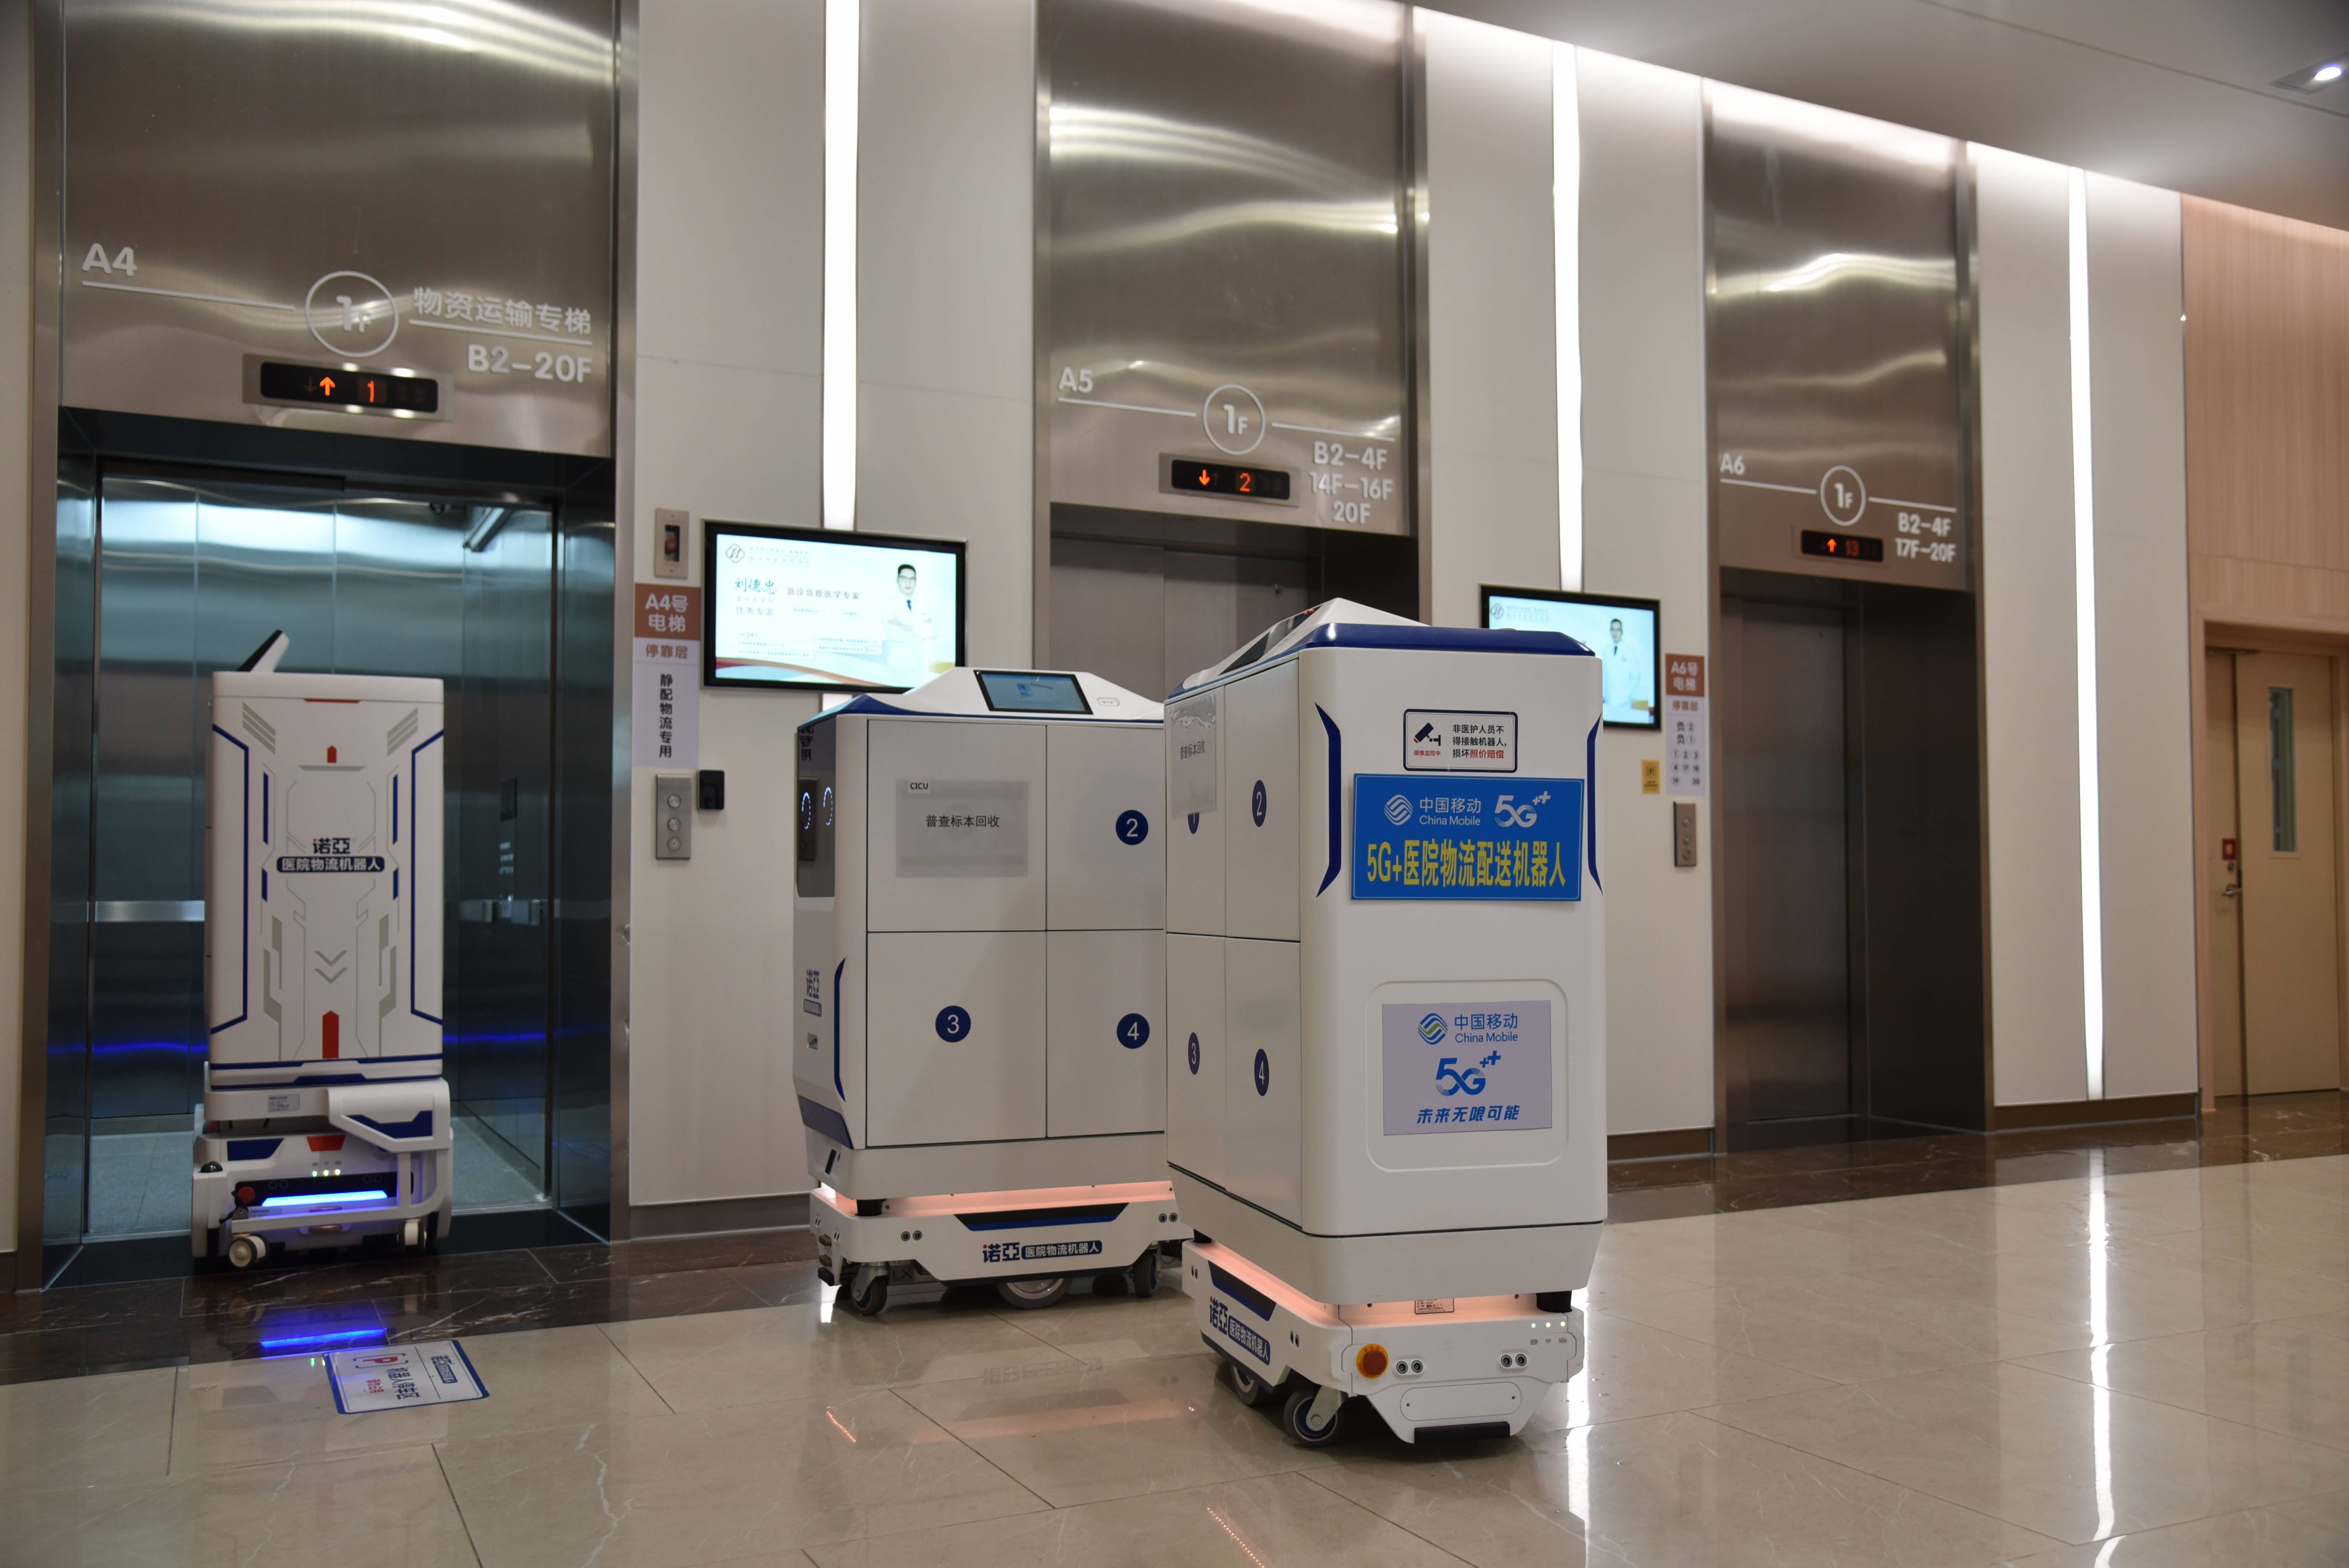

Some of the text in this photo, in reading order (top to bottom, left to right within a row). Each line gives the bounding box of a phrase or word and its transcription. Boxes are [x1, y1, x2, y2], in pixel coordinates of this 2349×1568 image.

[82, 243, 137, 277] A4
[336, 295, 372, 333] 1F
[413, 287, 592, 335] 物资运输专梯
[1058, 367, 1093, 393] A5
[367, 380, 374, 403] 1
[1223, 404, 1248, 435] 1F
[1720, 453, 1745, 476] A6
[1240, 473, 1250, 492] 2
[1834, 483, 1854, 509] 1F
[1332, 501, 1371, 525] 20F
[734, 577, 777, 595] 刘德忠
[787, 587, 859, 599] 急诊急救医学专家
[645, 593, 688, 613] A4号
[649, 614, 686, 633] 电梯
[645, 643, 688, 659] 停靠层
[1671, 661, 1698, 676] A6号
[1673, 677, 1697, 691] 电梯
[659, 674, 673, 758] 静配物流专用
[1452, 723, 1504, 734] 非医护人员不
[1452, 748, 1504, 759] 损坏照价赔偿
[1256, 791, 1262, 816] 2
[1419, 796, 1481, 814] 中国移动
[926, 814, 1000, 827] 普查标本回收
[1126, 818, 1138, 837] 2
[1419, 815, 1481, 826] China Mobile
[282, 857, 380, 871] 医院物流机器人
[1367, 838, 1566, 887] 5G+医院物流配送机器人
[947, 1015, 959, 1034] 3
[1127, 1021, 1139, 1041] 4
[1454, 1013, 1518, 1030] 中国移动
[1455, 1031, 1518, 1043] China Mobile
[1191, 1042, 1196, 1065] 3
[1258, 1060, 1265, 1085] 4
[1417, 1105, 1520, 1124] 未来无限可能
[1025, 1241, 1100, 1258] 医院物流机器人
[1230, 1319, 1269, 1361] 医院物流机器人
[386, 1367, 420, 1400] 机器人停车区
